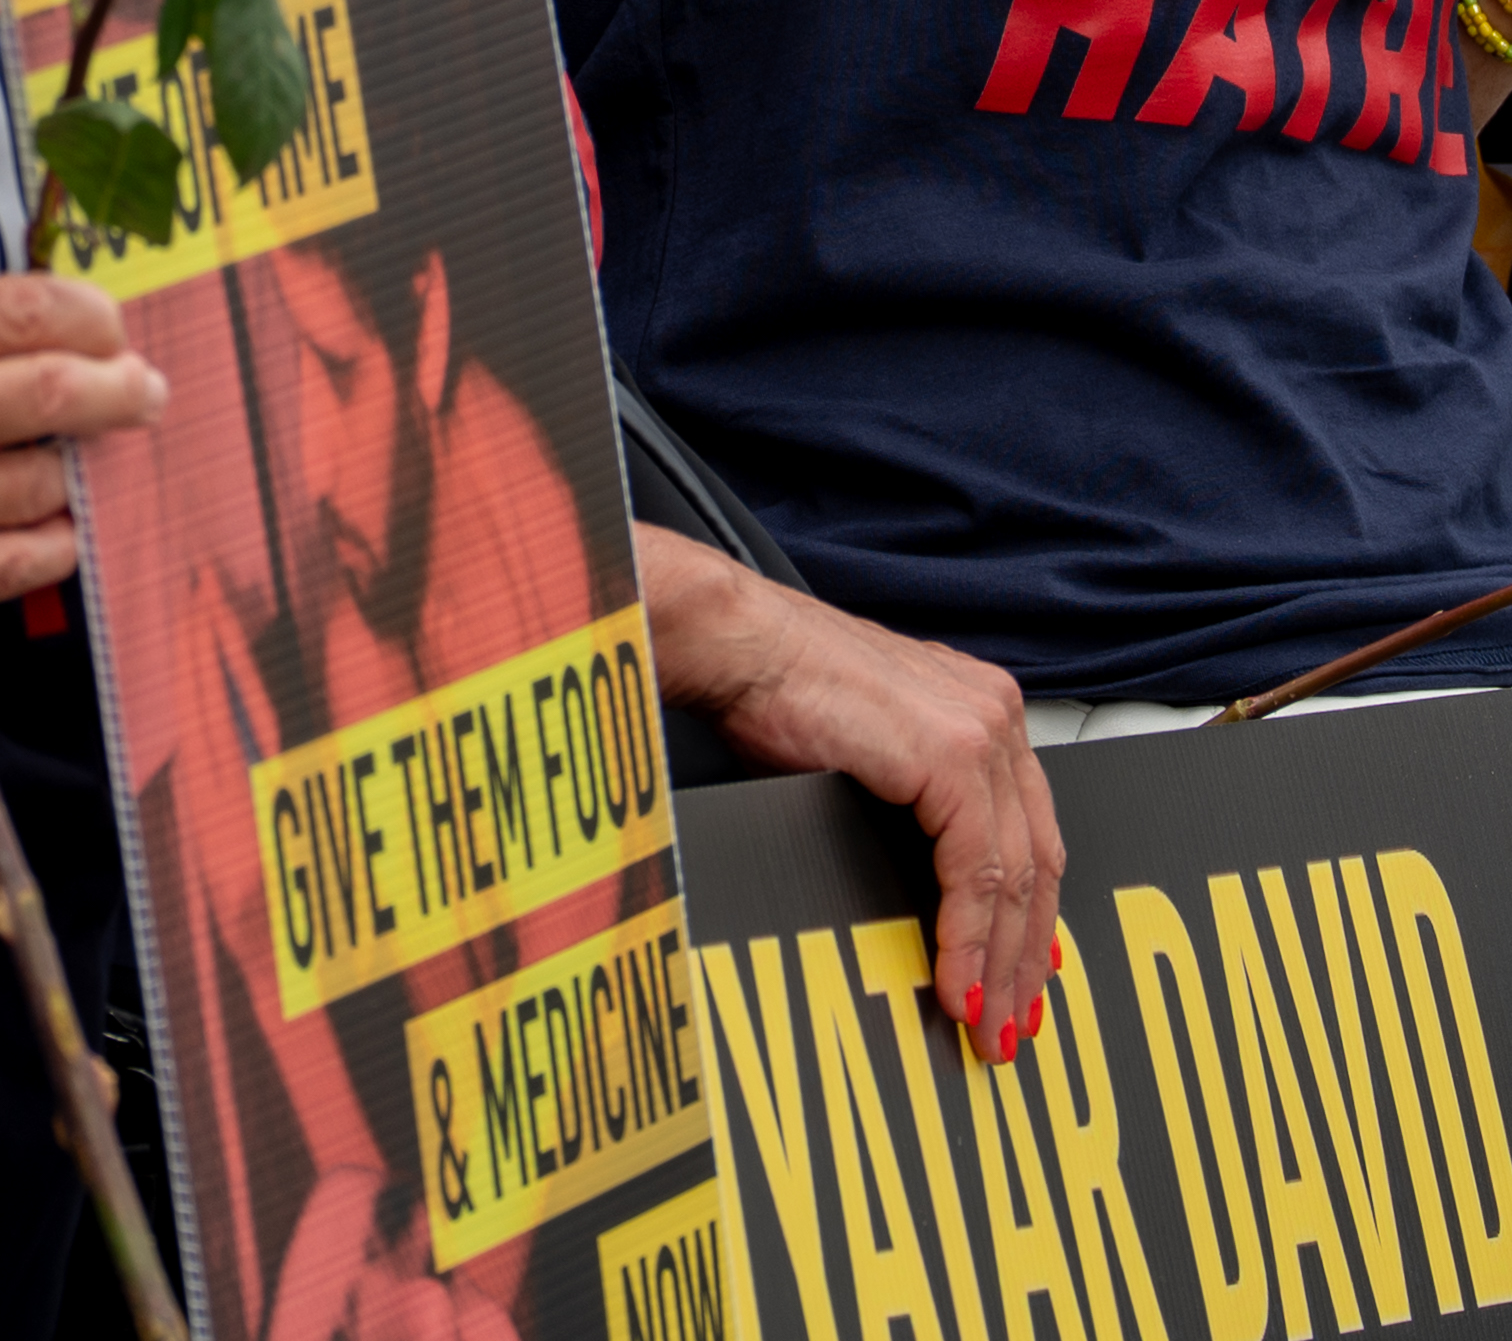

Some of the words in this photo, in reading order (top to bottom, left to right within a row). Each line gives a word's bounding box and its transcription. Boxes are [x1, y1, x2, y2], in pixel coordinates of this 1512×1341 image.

[272, 750, 396, 971] GIVE
[390, 692, 534, 917] THEM
[531, 639, 658, 858] FOOD
[431, 1057, 478, 1222] &
[474, 926, 700, 1201] MEDICINE
